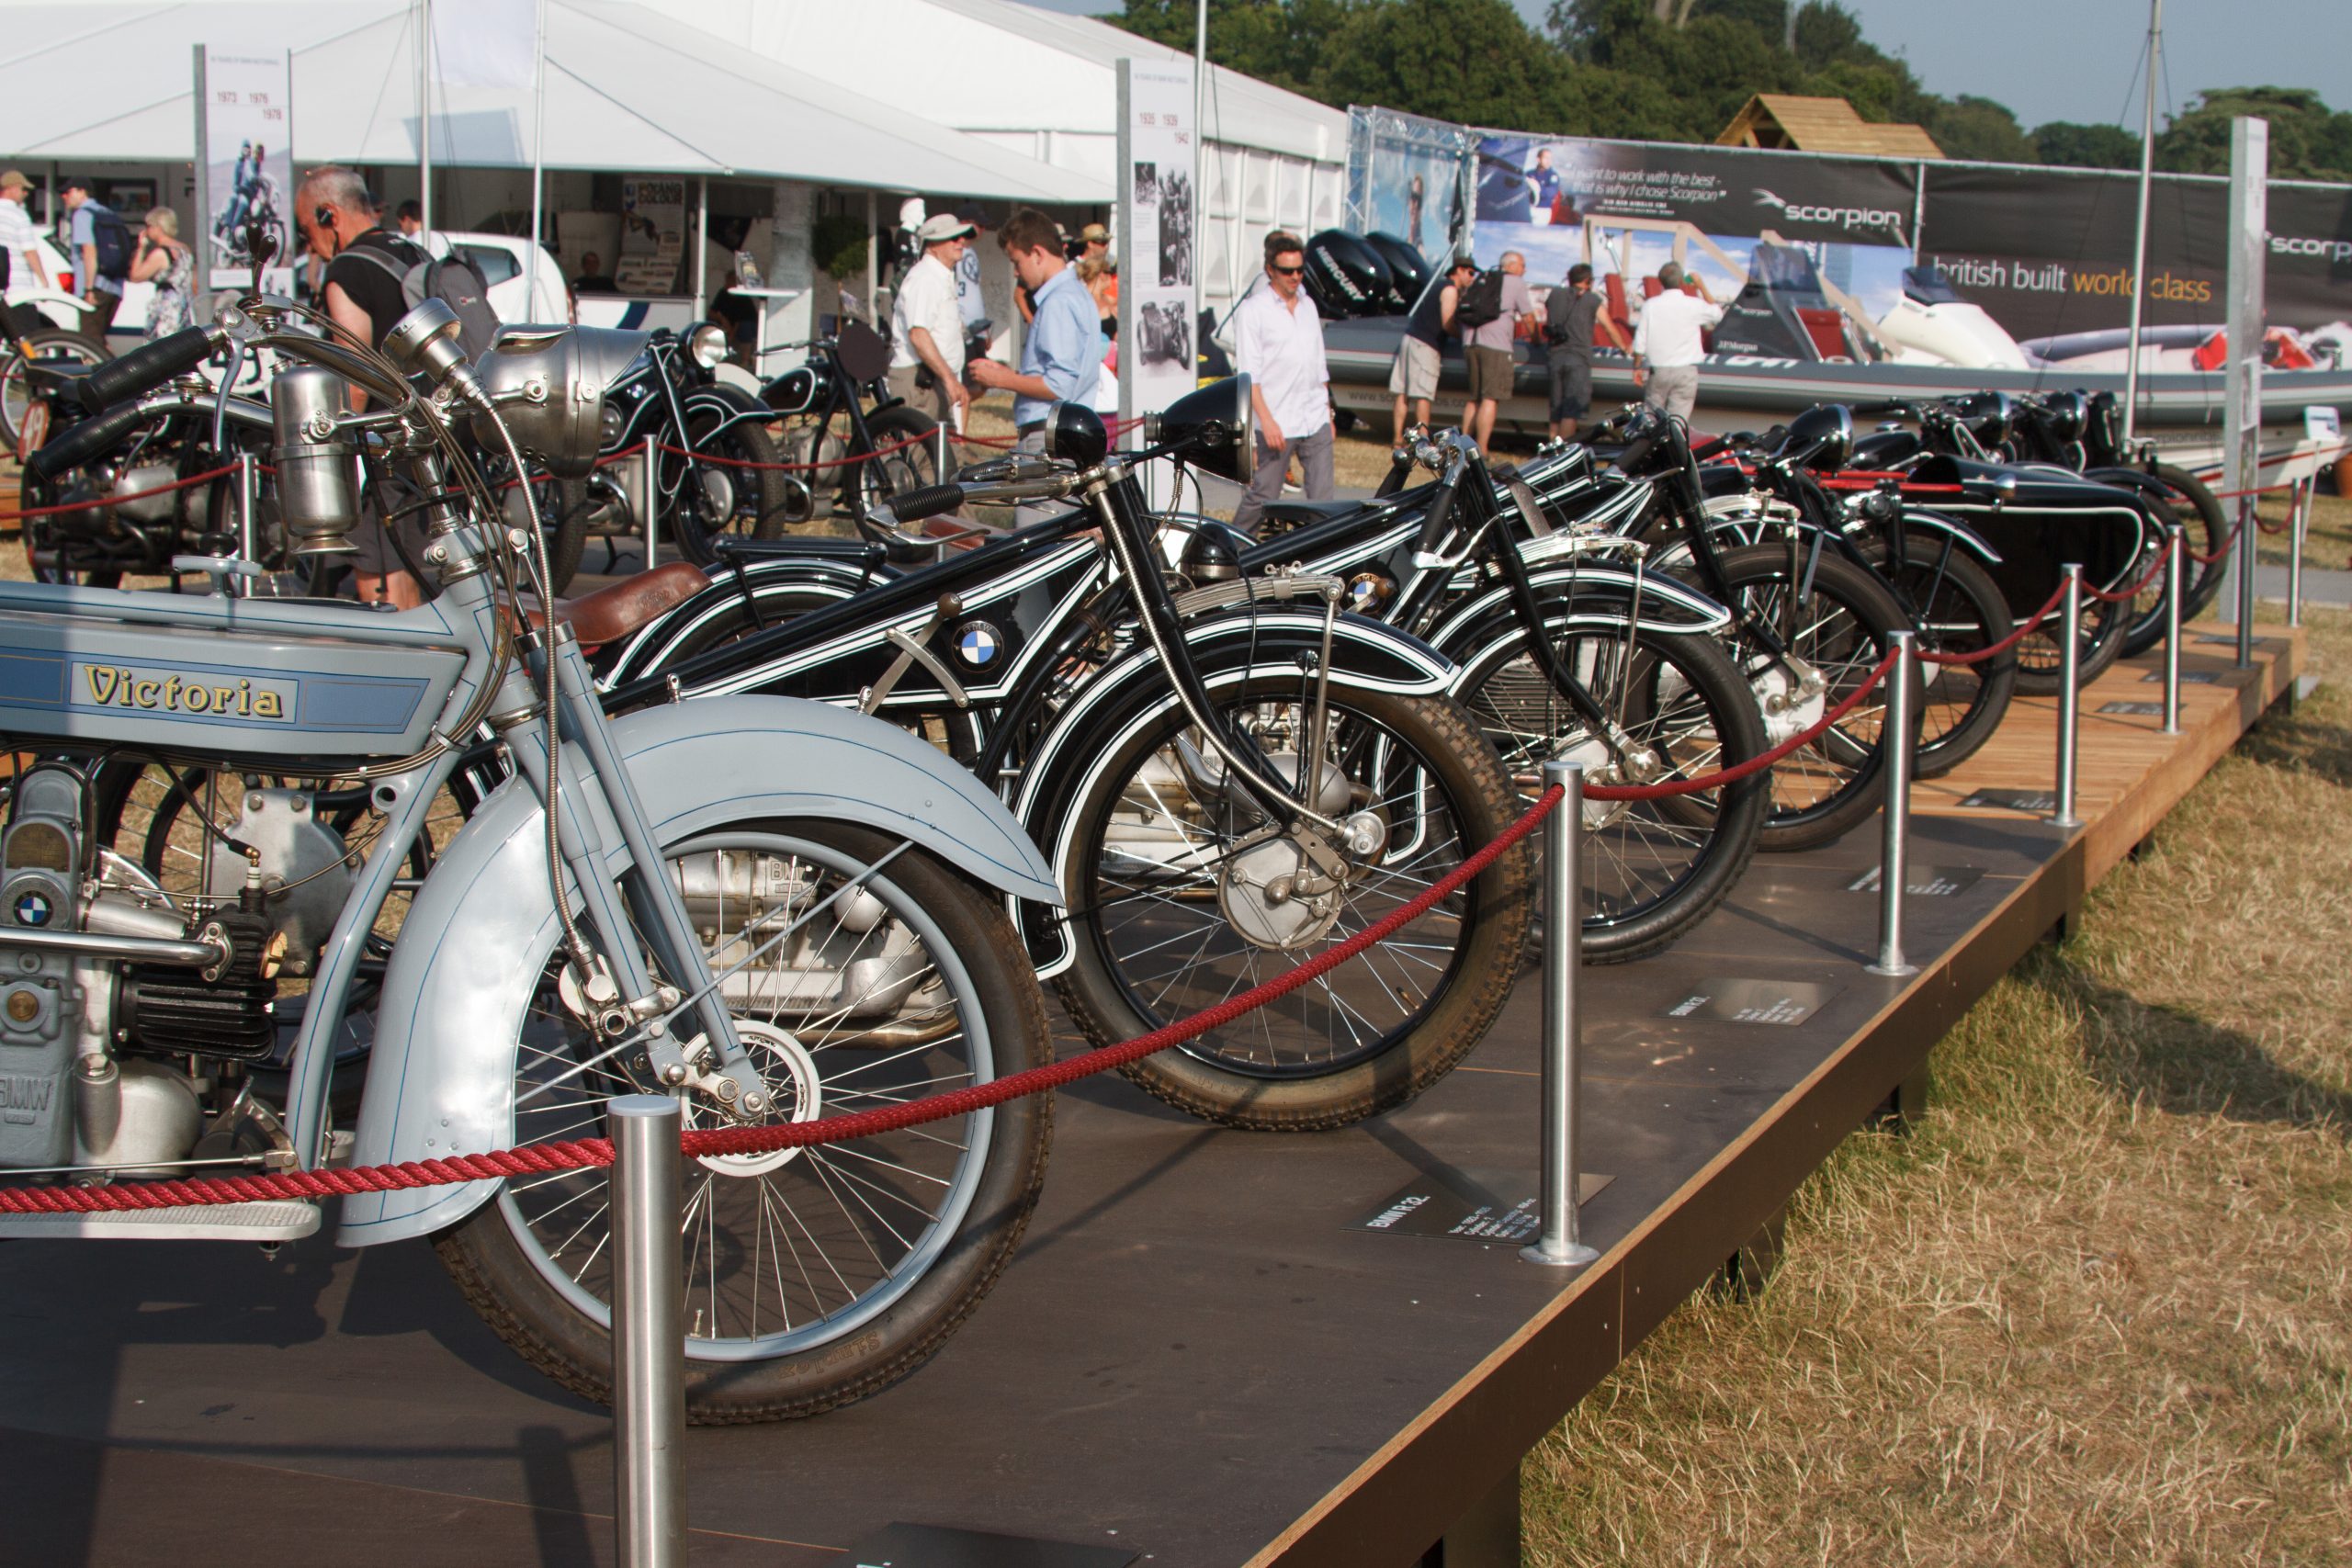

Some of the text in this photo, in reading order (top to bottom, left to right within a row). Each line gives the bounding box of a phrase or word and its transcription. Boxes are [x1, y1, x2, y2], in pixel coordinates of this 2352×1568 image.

[1572, 181, 1594, 193] that
[1594, 183, 1604, 194] is
[1606, 184, 1628, 197] why
[1634, 185, 1668, 198] chose
[1577, 168, 1604, 179] want
[1605, 168, 1617, 180] to
[1618, 169, 1645, 182] work
[1646, 171, 1669, 184] with
[1670, 171, 1690, 185] the
[1690, 173, 1715, 186] best
[1785, 205, 1901, 230] scorpion
[1316, 245, 1367, 301] MERCURY
[1932, 255, 2007, 288] british
[2012, 260, 2067, 293] built
[2150, 272, 2211, 302] class
[963, 621, 993, 634] BMW
[84, 664, 283, 719] Victoria
